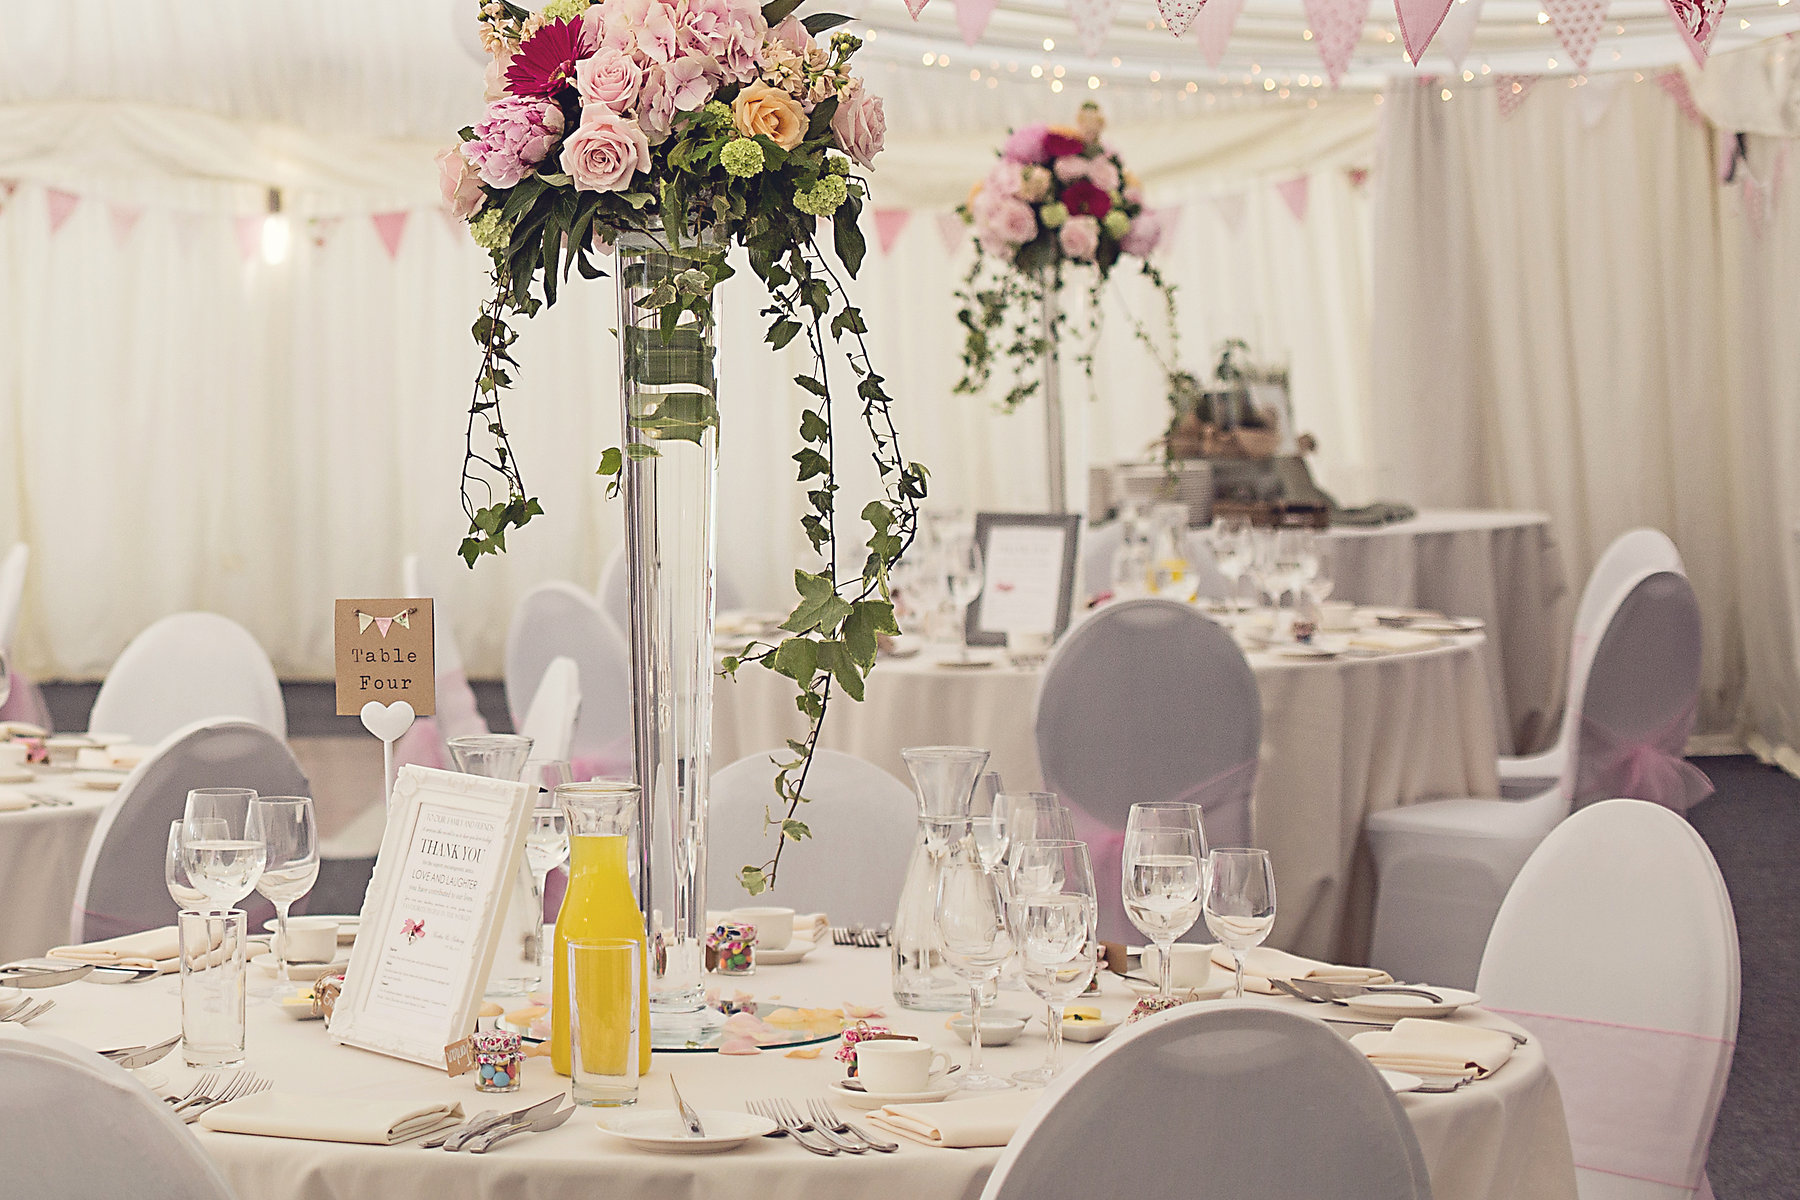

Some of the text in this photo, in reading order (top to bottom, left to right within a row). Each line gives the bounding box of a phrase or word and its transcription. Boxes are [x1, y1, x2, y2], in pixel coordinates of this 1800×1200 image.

[352, 648, 417, 663] Table
[359, 675, 412, 690] Four
[420, 838, 487, 864] THANK YOU
[411, 869, 478, 890] LOVE AND LAUGHTER
